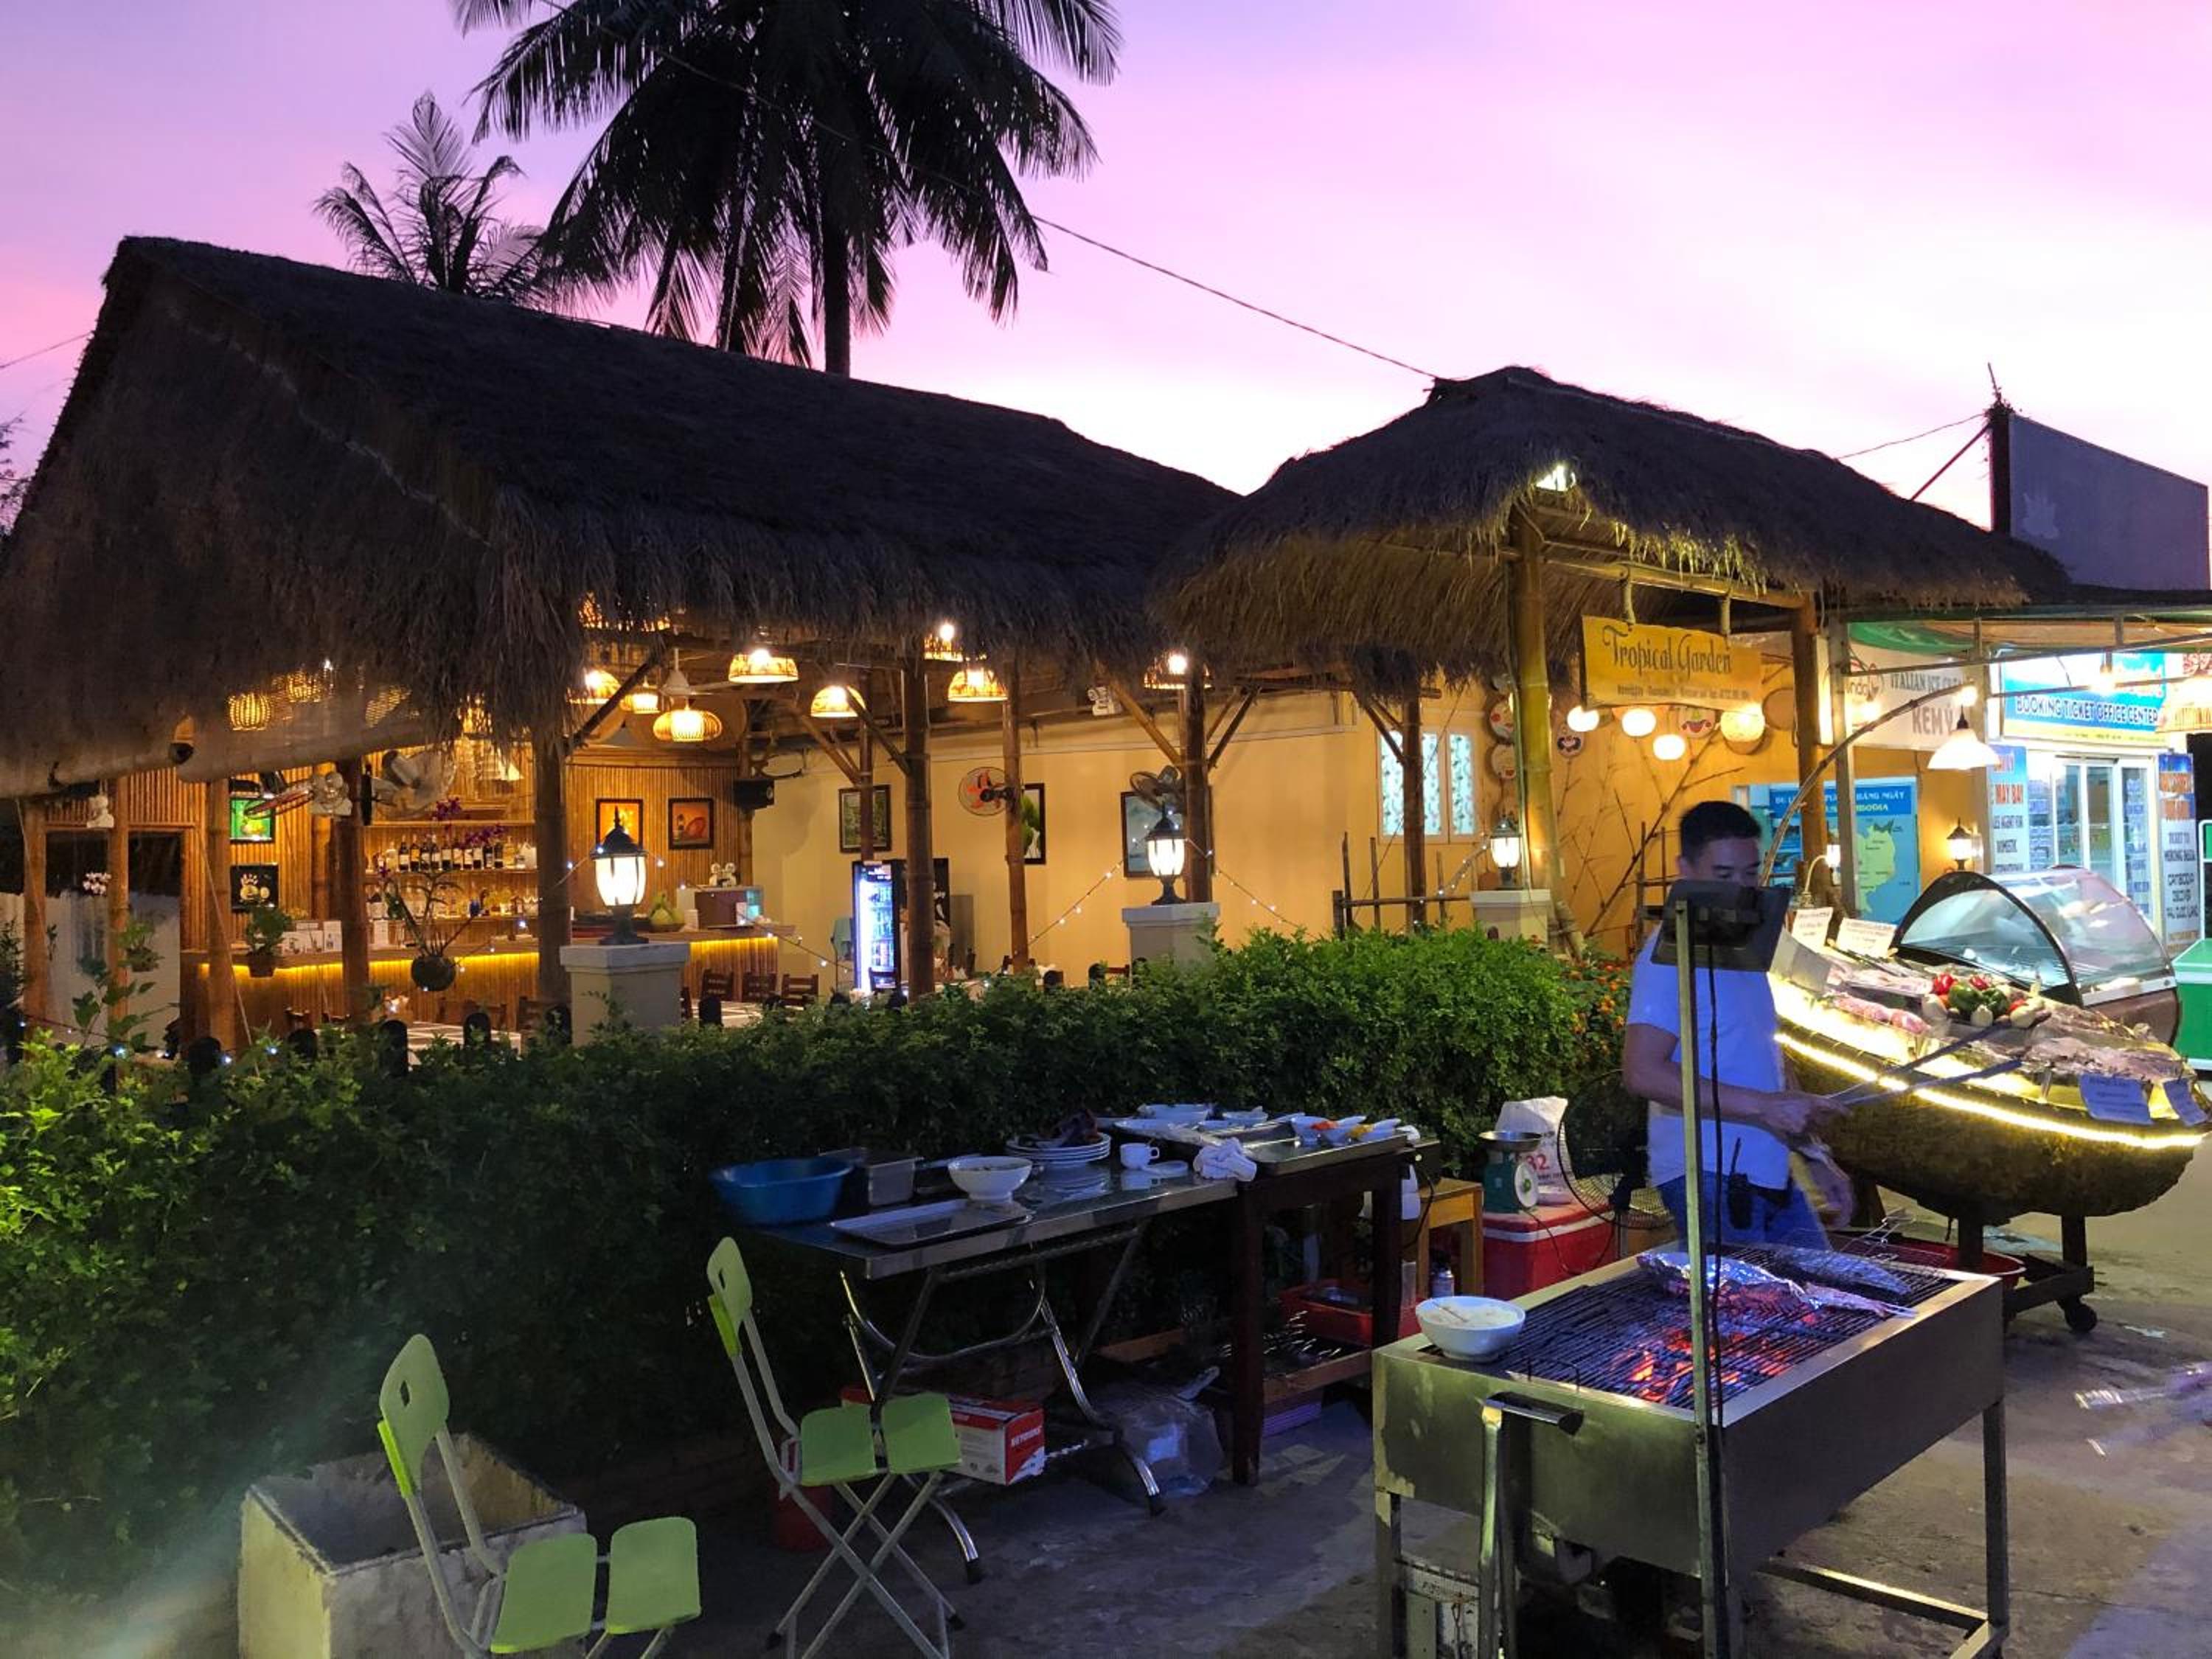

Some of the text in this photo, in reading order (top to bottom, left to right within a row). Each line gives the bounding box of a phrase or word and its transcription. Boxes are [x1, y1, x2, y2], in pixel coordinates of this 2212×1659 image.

[1603, 625, 1733, 681] Tropical Garden
[1891, 672, 1926, 691] ITALIAN
[1912, 706, 1943, 734] KEM
[2016, 695, 2062, 716] BOOKING
[2064, 700, 2095, 719] TICKET
[2097, 703, 2126, 722] OFFICE
[2127, 706, 2158, 724] CENTER
